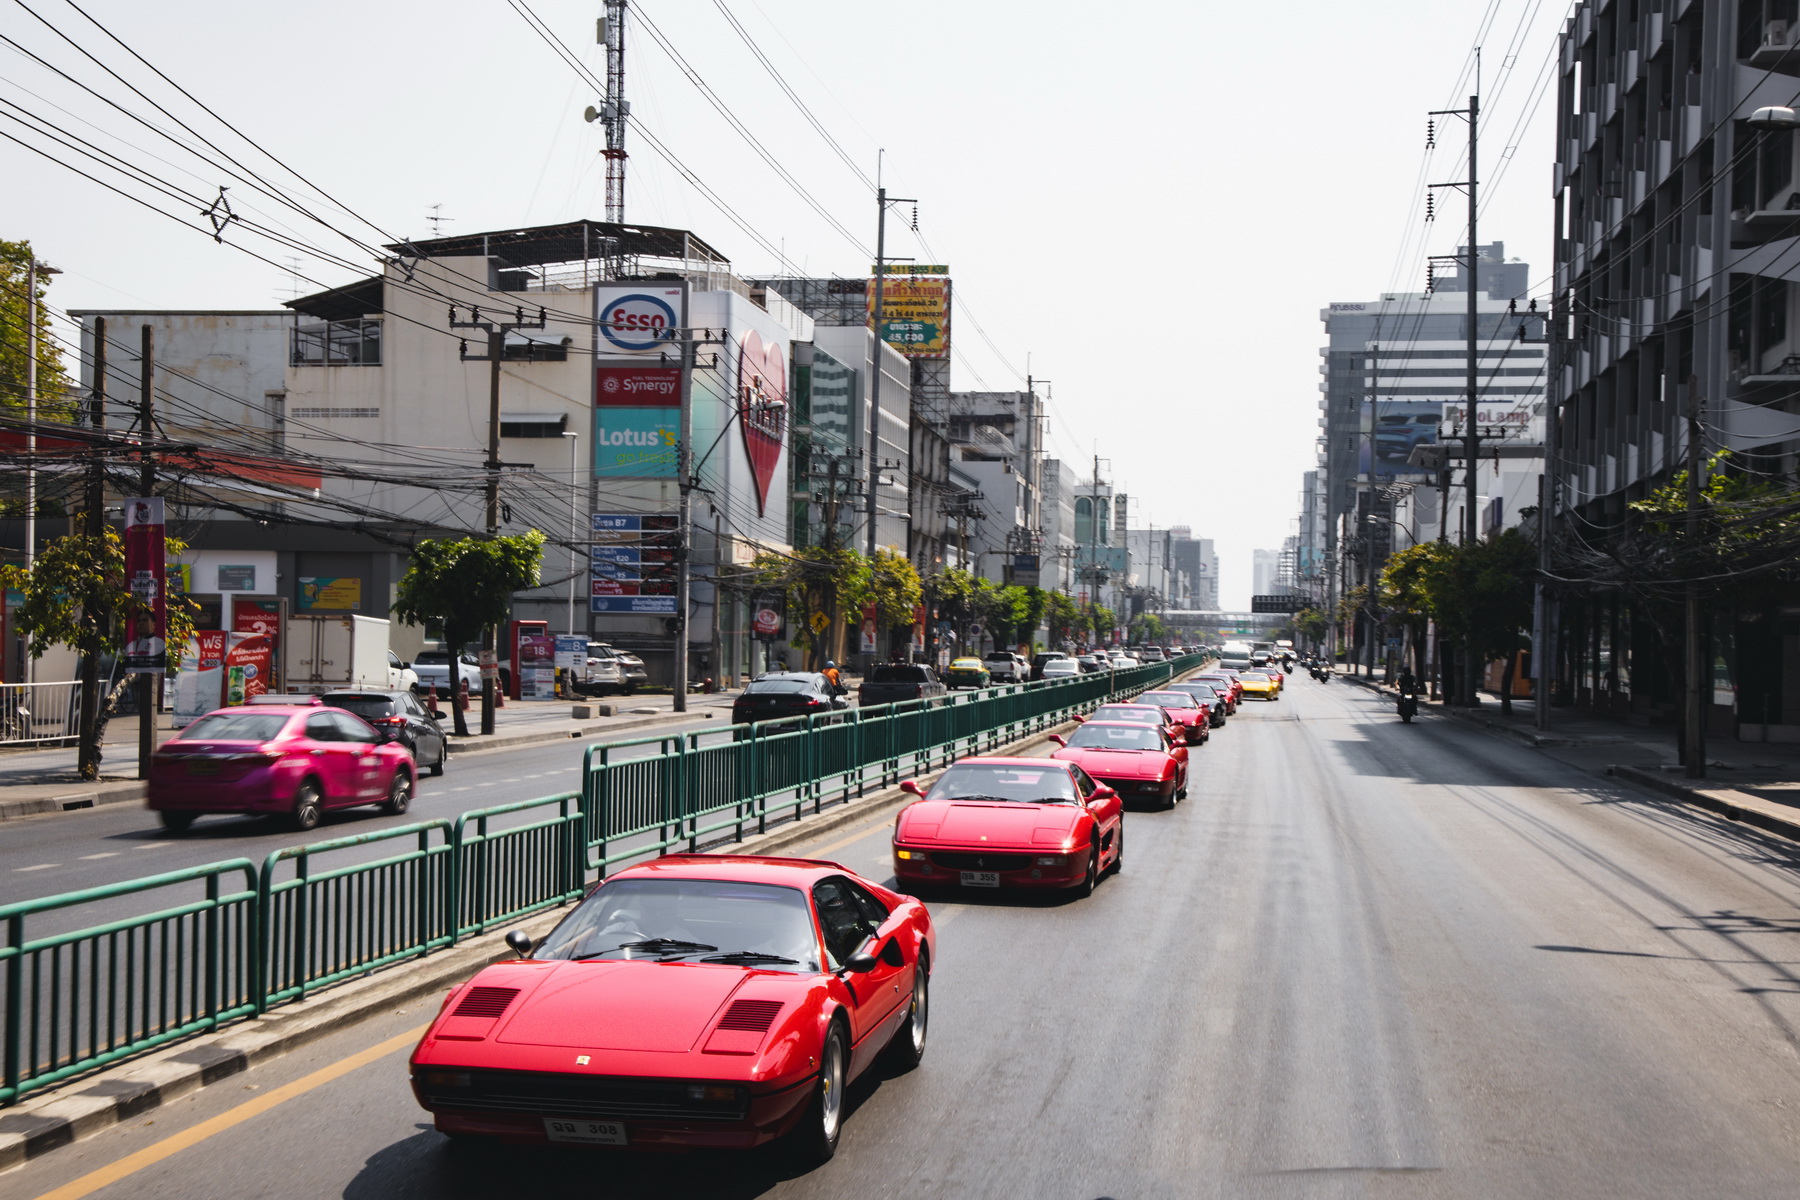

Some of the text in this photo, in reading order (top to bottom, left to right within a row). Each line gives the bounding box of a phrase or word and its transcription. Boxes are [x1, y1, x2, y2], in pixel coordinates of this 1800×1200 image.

[613, 308, 665, 332] Esso
[623, 379, 676, 394] Synergy
[599, 428, 677, 446] Lotus's
[615, 519, 627, 527] B7
[203, 635, 223, 649] ฟรี
[980, 873, 996, 881] 355
[588, 1124, 618, 1135] 308
